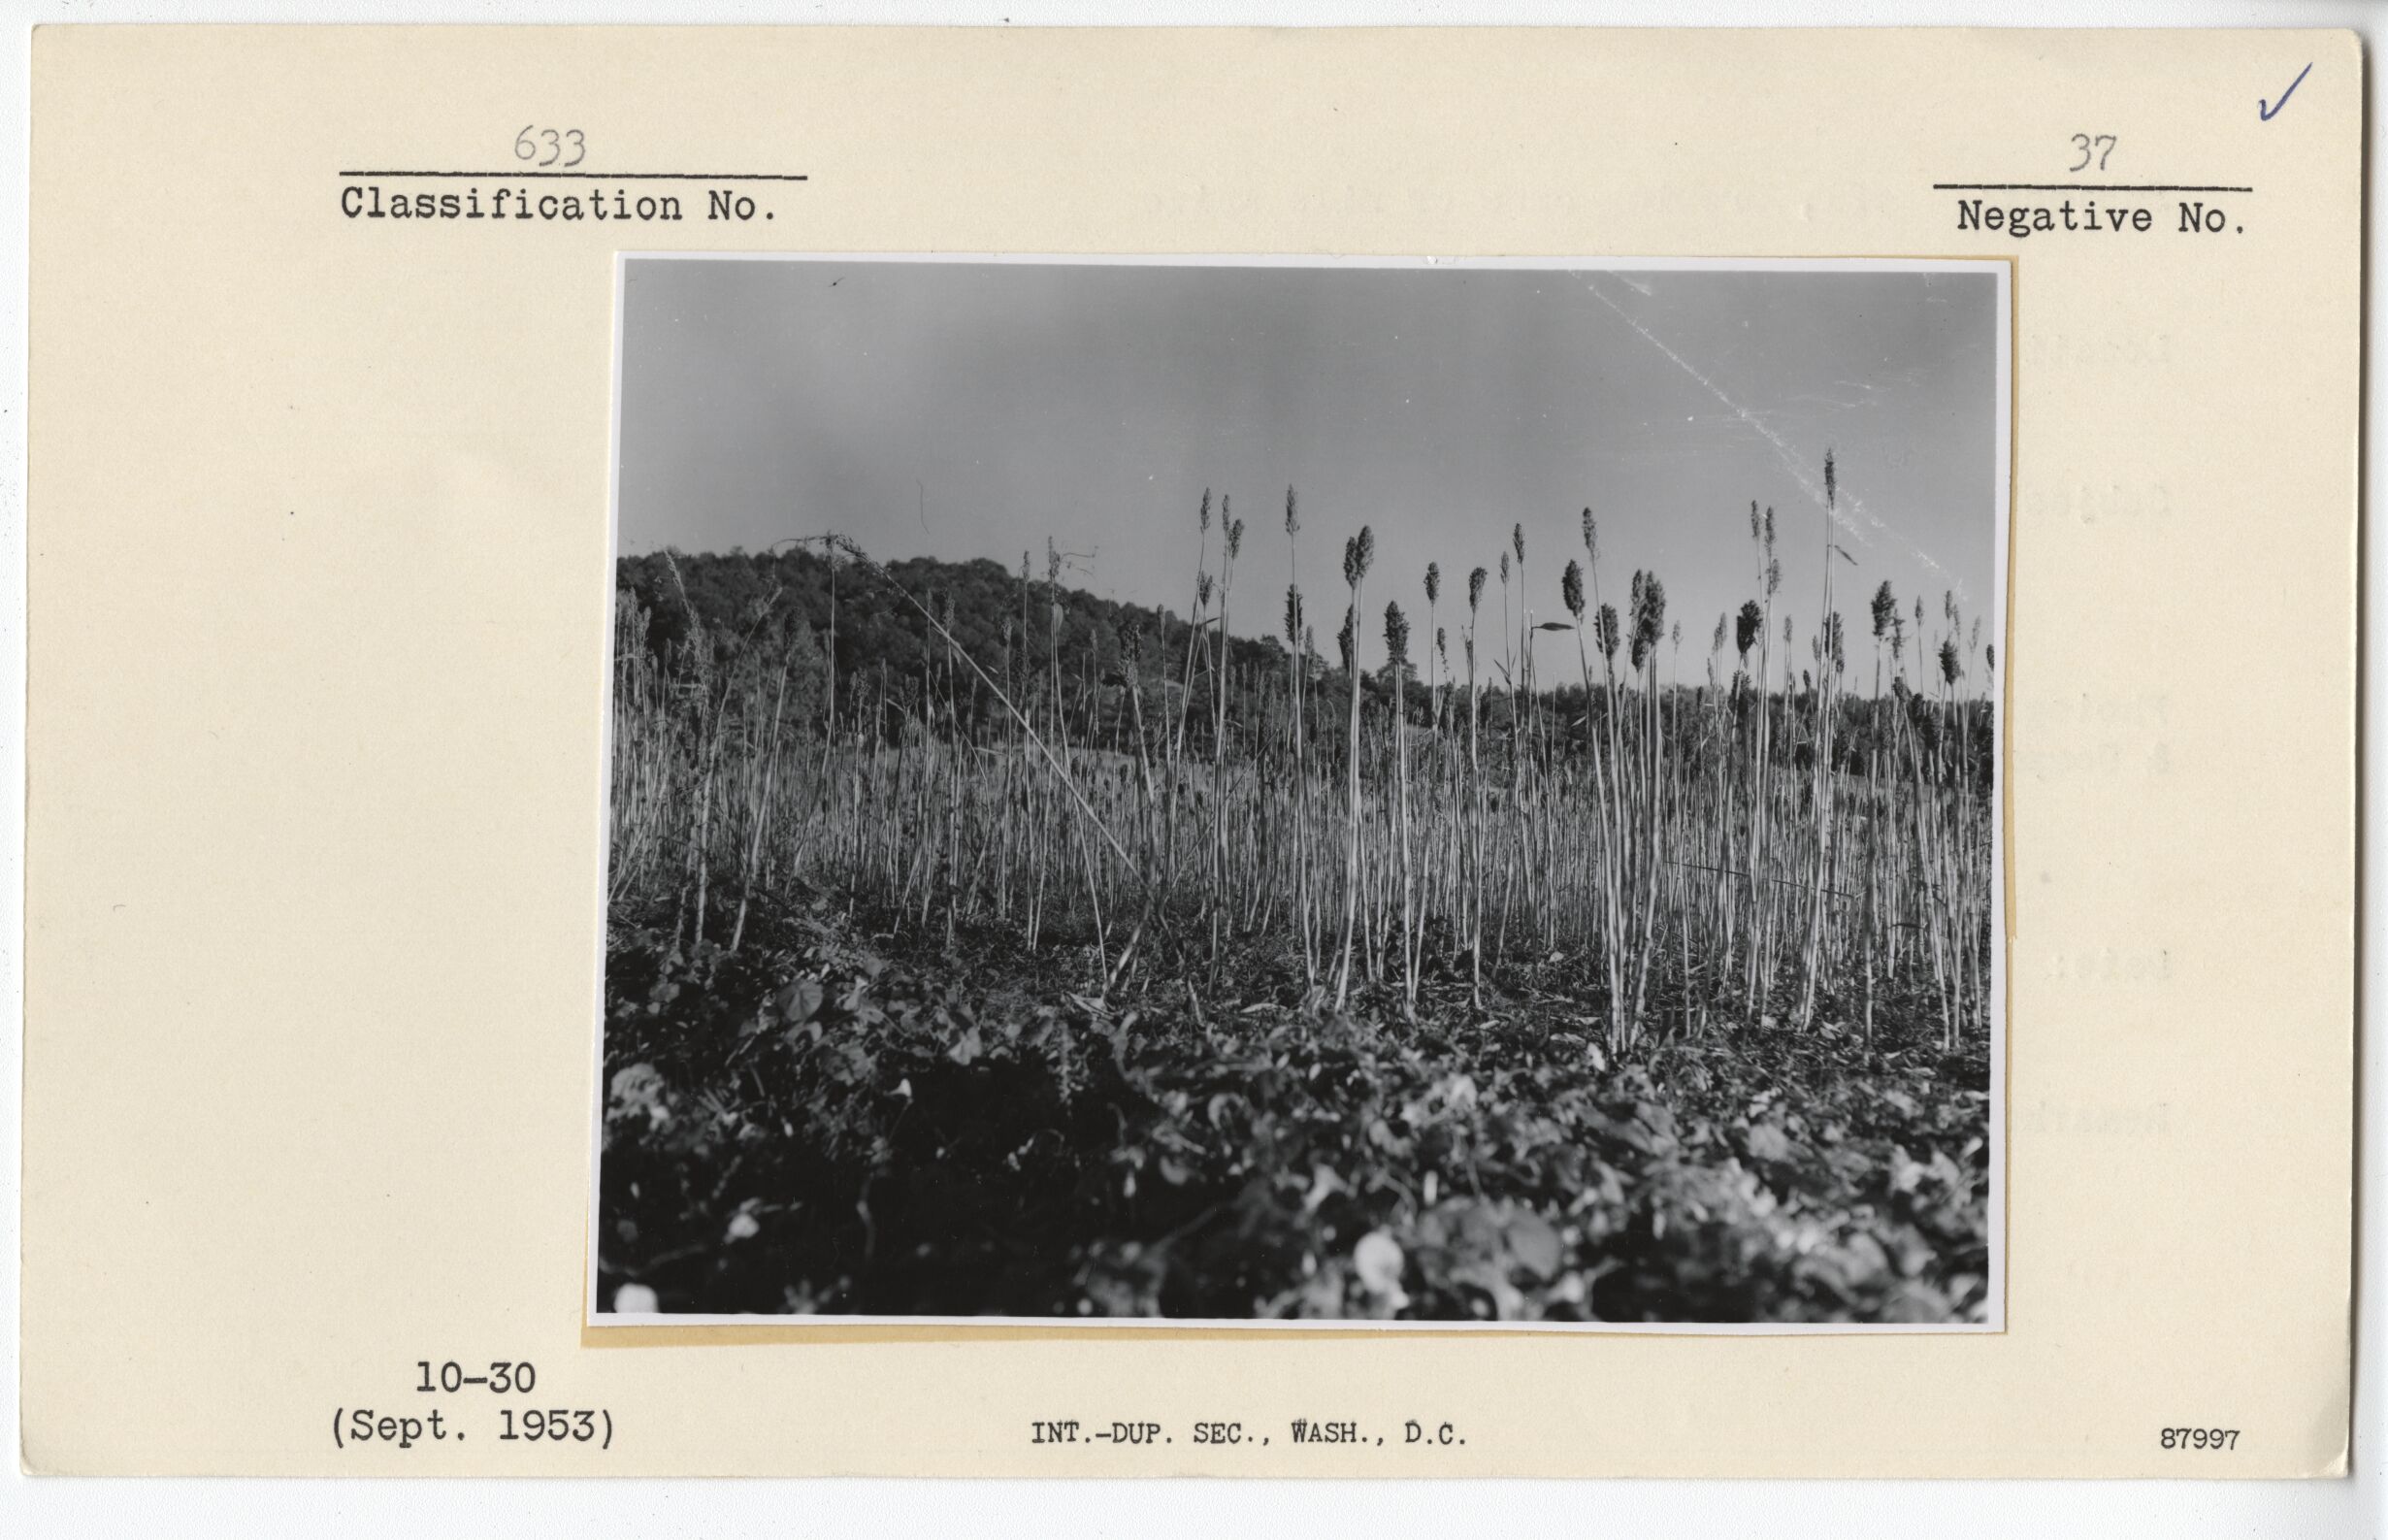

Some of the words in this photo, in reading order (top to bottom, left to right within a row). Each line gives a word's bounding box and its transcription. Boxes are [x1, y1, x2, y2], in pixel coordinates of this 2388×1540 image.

[514, 124, 586, 167] 633
[2069, 133, 2117, 172] 37
[341, 185, 683, 221] Classification
[707, 189, 774, 221] No.
[1956, 199, 2153, 238] Negative
[2177, 202, 2243, 234] No.
[416, 1360, 537, 1393] 10-30
[333, 1407, 466, 1449] (Sept.
[499, 1409, 612, 1450] 1953)
[1031, 1420, 1173, 1444] INT.-DUP.
[1193, 1422, 1270, 1446] SEC.,
[1291, 1419, 1385, 1447] WASH.,
[1404, 1420, 1467, 1445] D.C.
[2160, 1426, 2241, 1451] 87997
